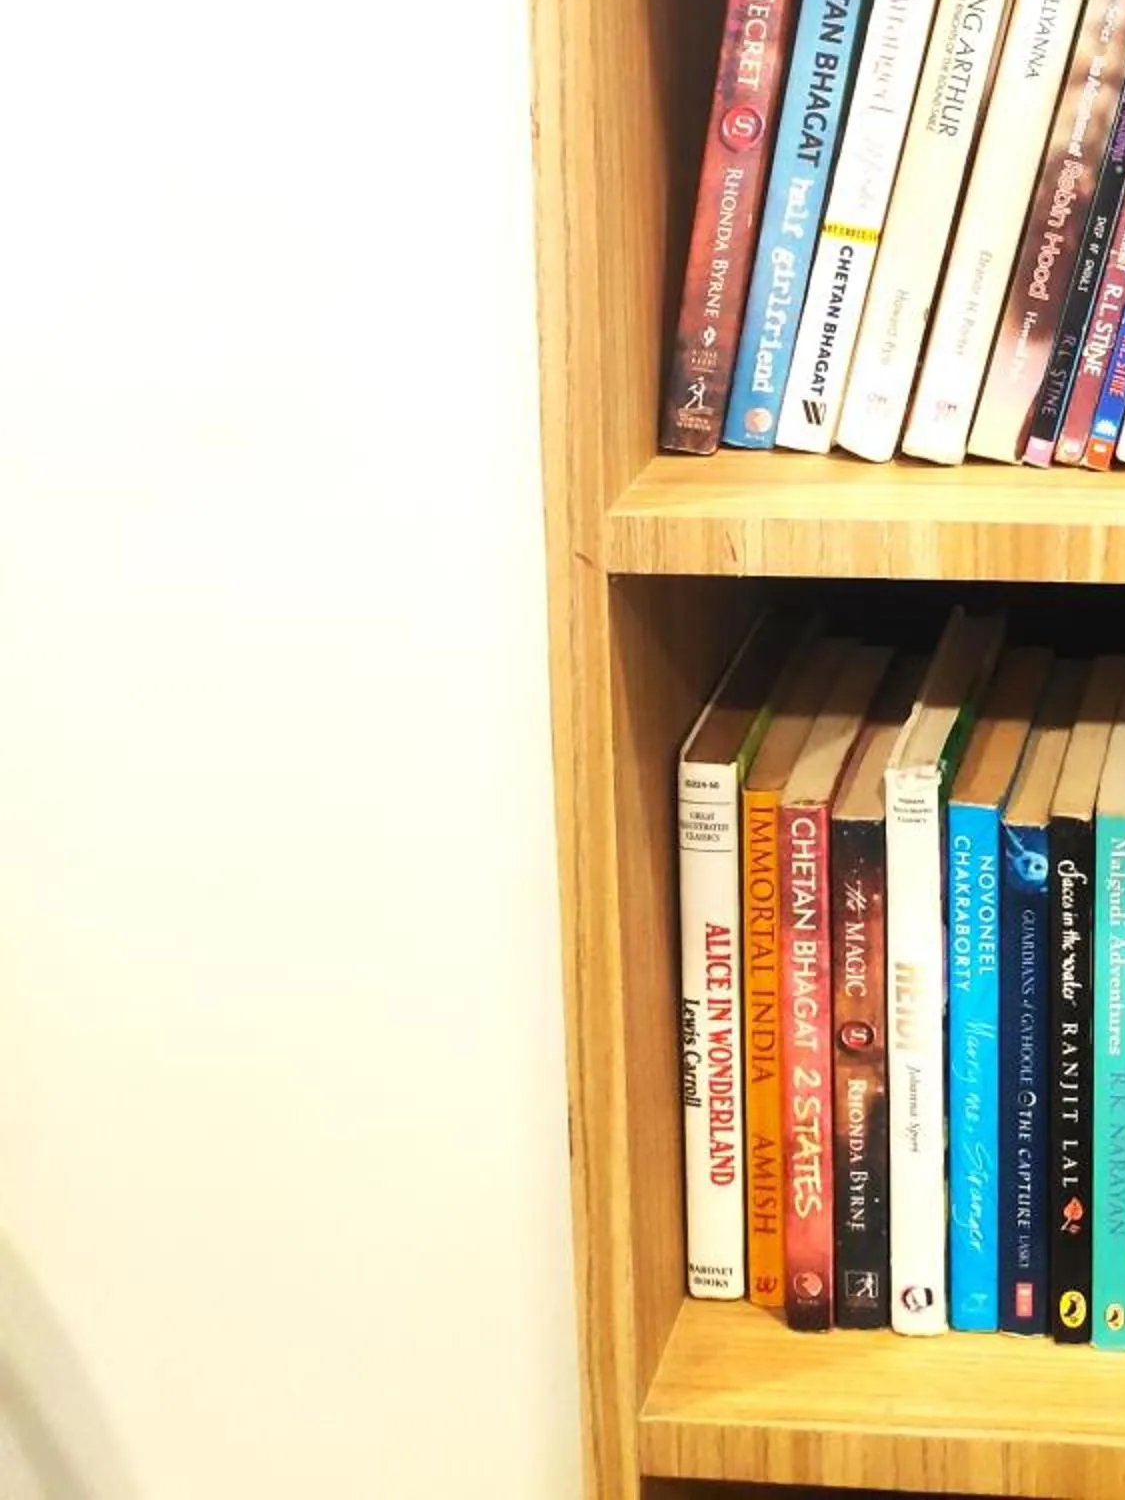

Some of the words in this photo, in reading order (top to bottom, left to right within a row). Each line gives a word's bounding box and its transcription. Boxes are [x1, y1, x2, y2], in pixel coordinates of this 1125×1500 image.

[793, 49, 839, 169] BHAGAT
[935, 36, 978, 140] ARTHUR
[712, 167, 743, 254] RHONDA
[779, 175, 816, 241] half
[1045, 157, 1085, 232] Robin
[702, 258, 728, 320] BYRNE
[823, 243, 856, 319] CHETAN
[1025, 230, 1066, 302] Hood
[745, 245, 801, 397] girlfriend
[806, 319, 839, 398] BHAGAT
[747, 807, 776, 978] IMMORTAL
[790, 816, 817, 931] CHETAN
[952, 834, 971, 994] CHAKRABORTY
[977, 854, 996, 977] NOVONEEL
[704, 921, 732, 992] ALICE
[791, 937, 818, 1053] BHAGAT
[681, 997, 701, 1045] Lewis
[706, 996, 732, 1022] IN
[749, 990, 776, 1084] INDIA
[681, 1049, 702, 1108] Carroll
[706, 1026, 734, 1188] WONDERLAND
[791, 1065, 822, 1089] 2
[1059, 1021, 1079, 1123] RANJIT
[790, 1092, 823, 1221] STATES
[846, 1077, 869, 1164] RHONDA
[1017, 1109, 1032, 1143] THE
[751, 1132, 778, 1236] AMISH
[846, 1169, 869, 1231] BYRNE
[1015, 1147, 1032, 1229] CAPTURE
[1060, 1138, 1079, 1188] LAL
